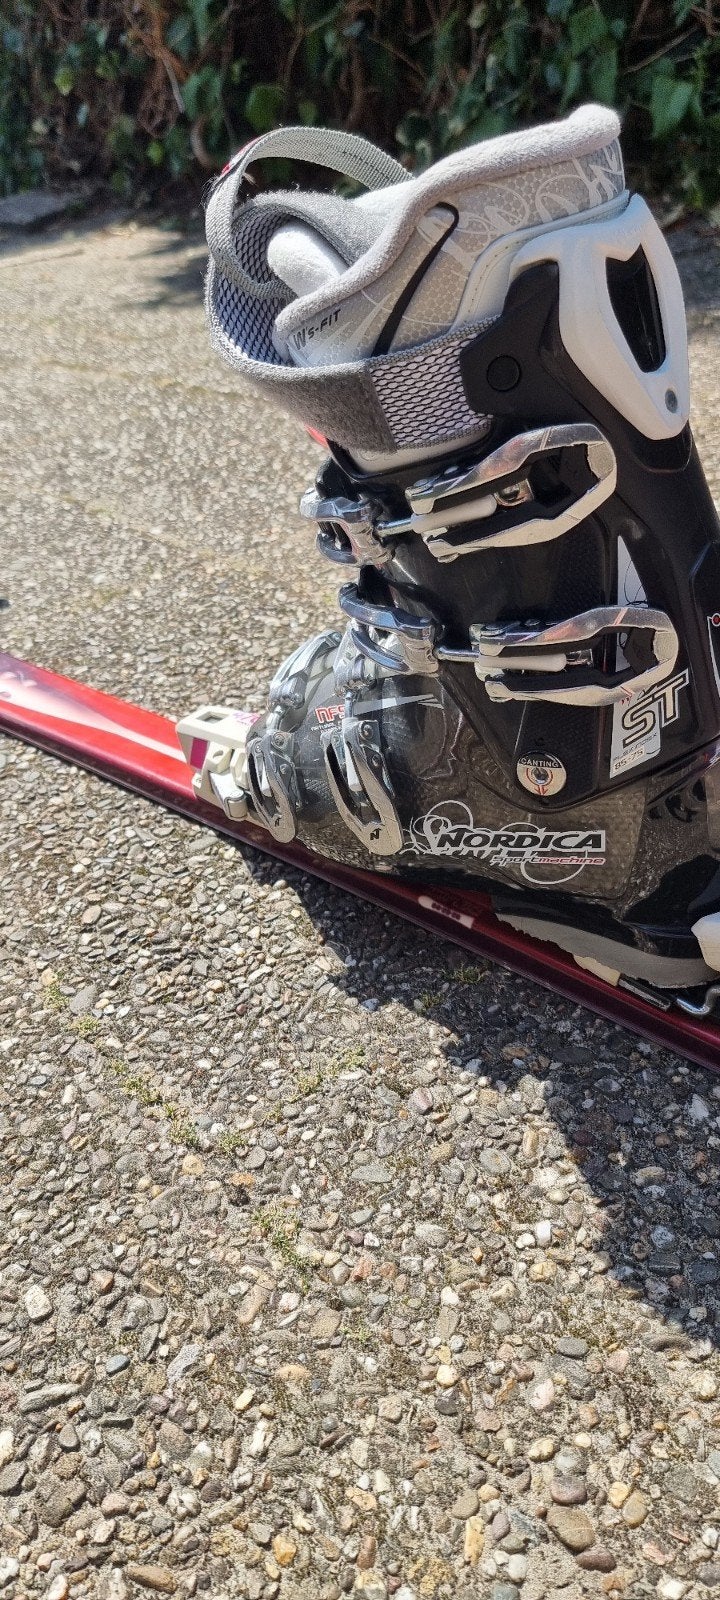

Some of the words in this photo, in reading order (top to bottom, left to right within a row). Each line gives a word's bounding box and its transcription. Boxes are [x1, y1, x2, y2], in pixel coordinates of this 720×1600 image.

[622, 668, 689, 748] ST
[520, 757, 559, 768] CANTING
[435, 827, 603, 850] NORDICA
